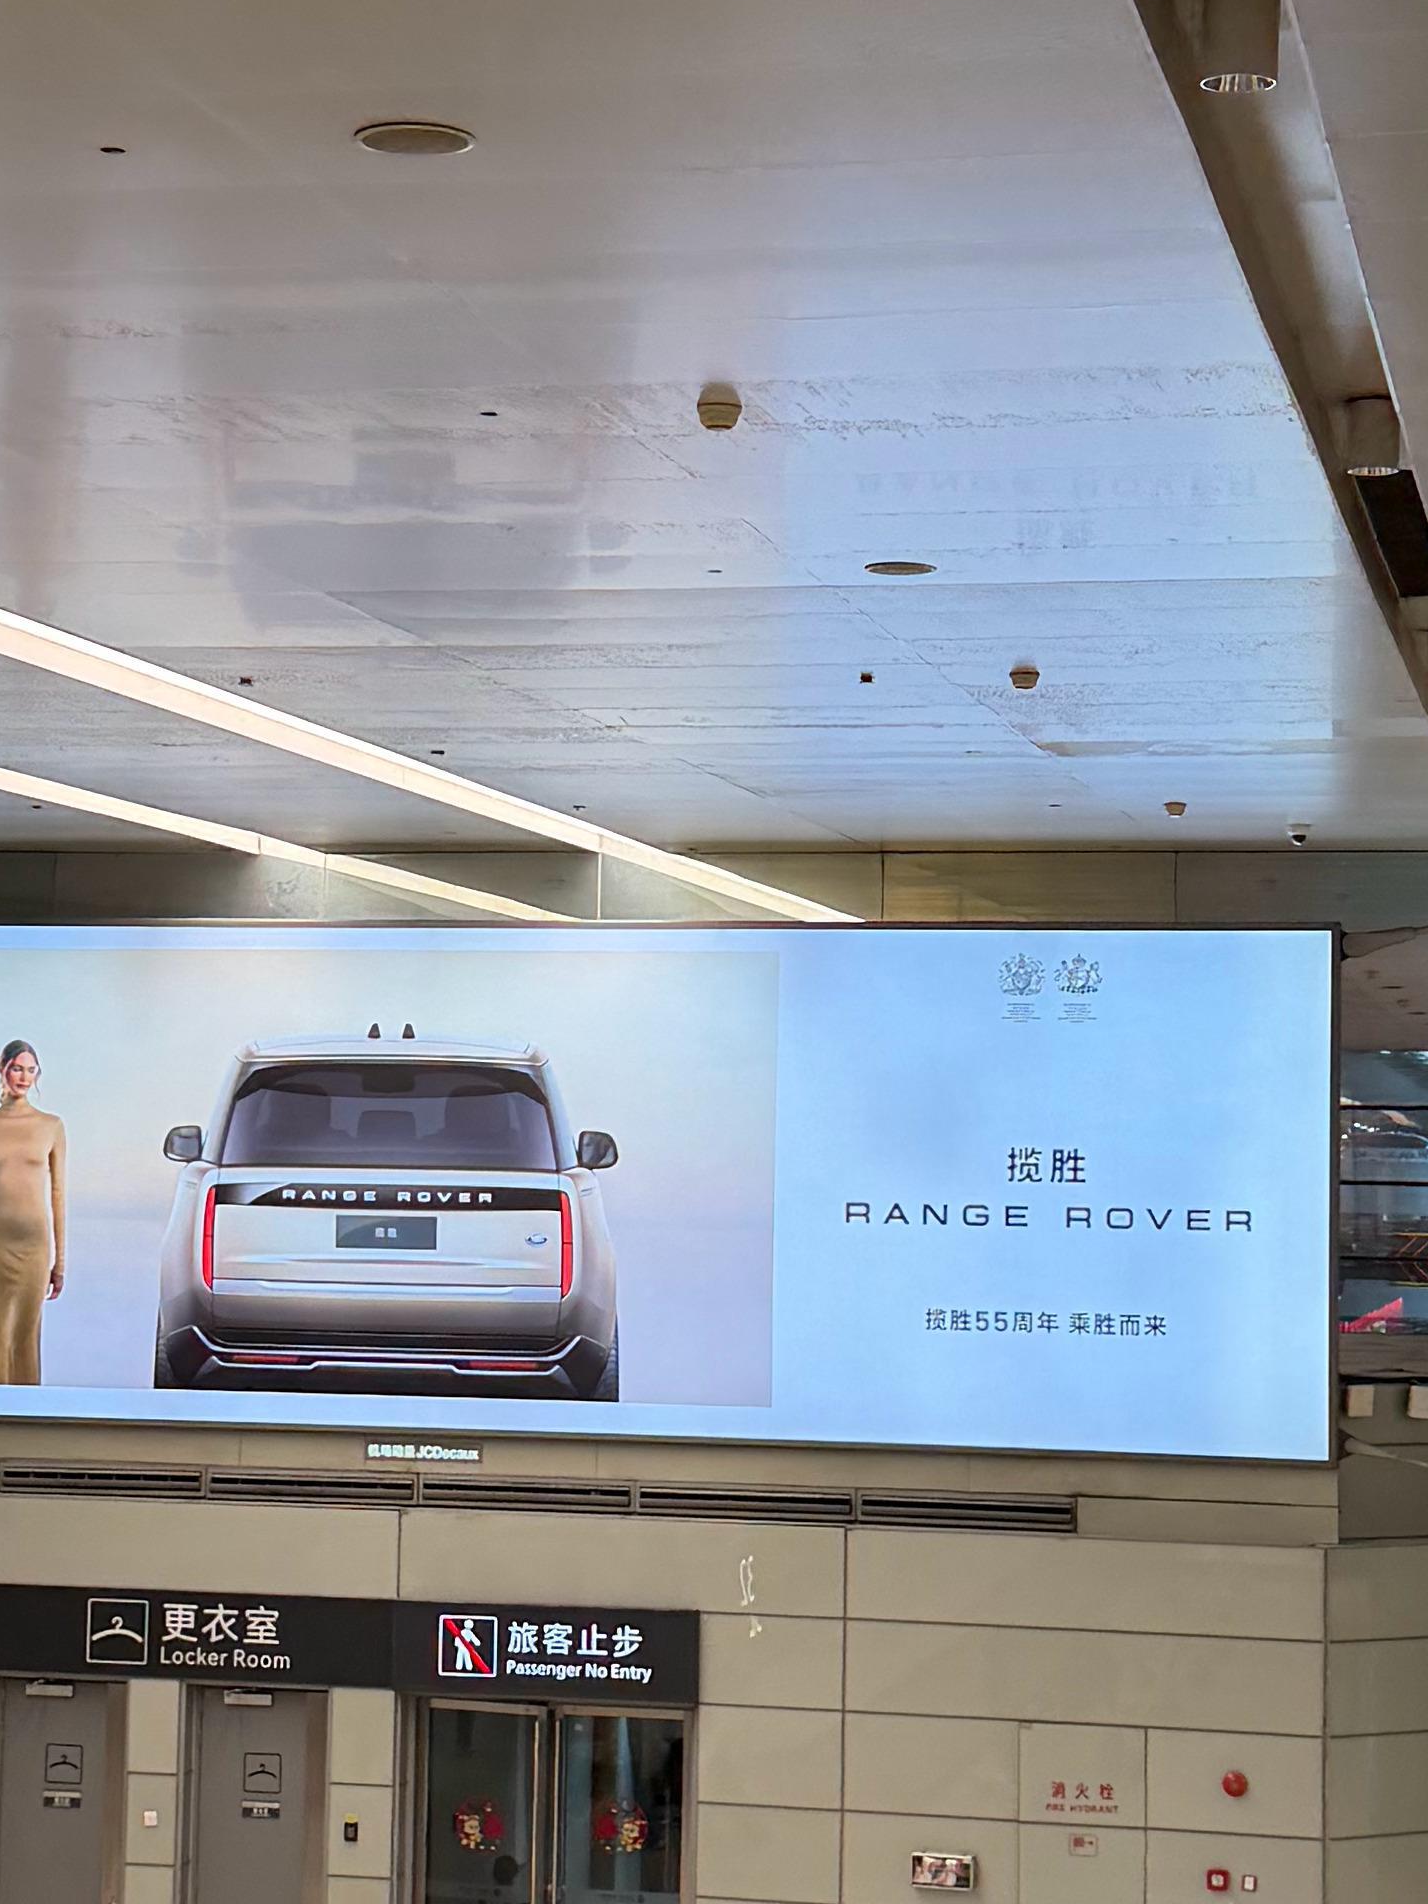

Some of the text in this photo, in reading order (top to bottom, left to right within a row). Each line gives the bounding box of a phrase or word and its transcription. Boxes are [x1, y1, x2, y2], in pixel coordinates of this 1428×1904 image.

[1007, 1146, 1086, 1184] 揽胜
[282, 1189, 493, 1203] RANGE ROVER
[845, 1201, 1252, 1232] RANGE ROVER
[925, 1308, 1167, 1337] 揽胜55周年 乘胜而来
[162, 1603, 280, 1645] 更衣室
[507, 1621, 643, 1658] 旅客止步
[160, 1646, 291, 1669] Locker Room
[506, 1659, 652, 1684] Passenger No Entry
